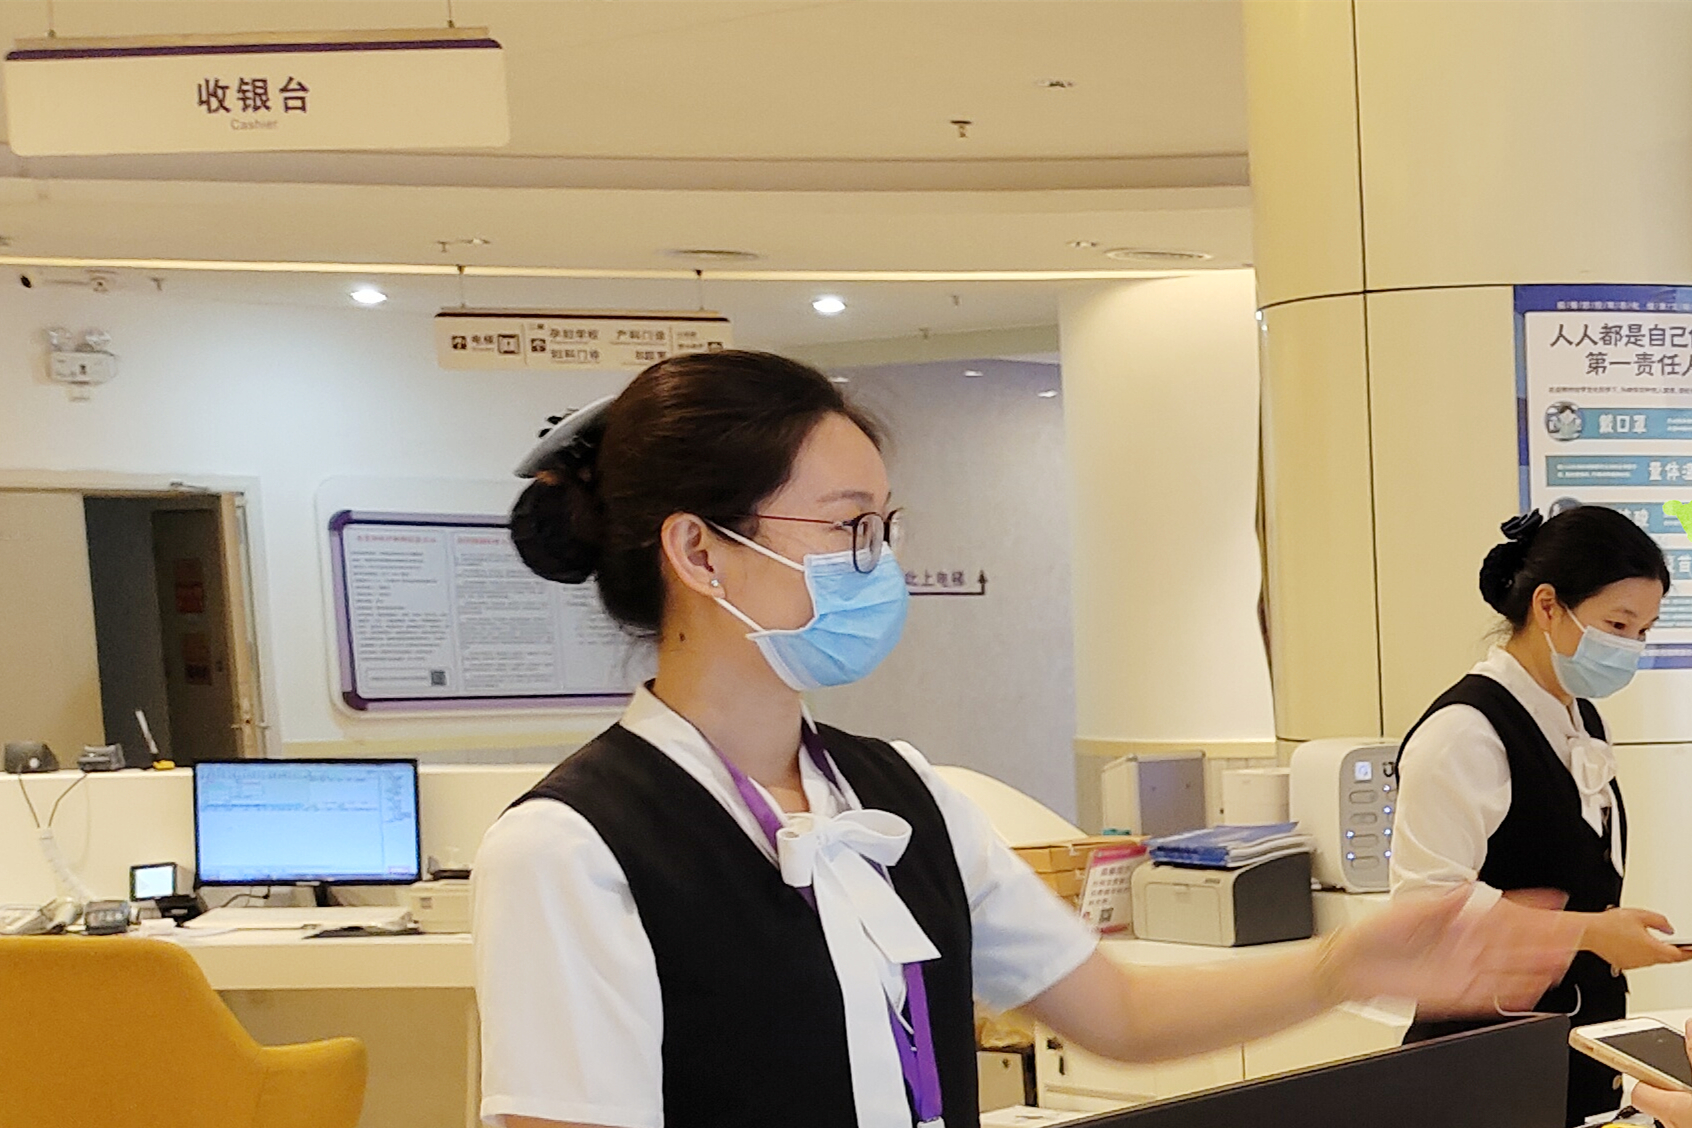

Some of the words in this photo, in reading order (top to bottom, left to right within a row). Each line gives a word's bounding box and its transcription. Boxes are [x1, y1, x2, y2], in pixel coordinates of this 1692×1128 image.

[197, 76, 310, 113] 收银台
[231, 119, 279, 130] Cashier
